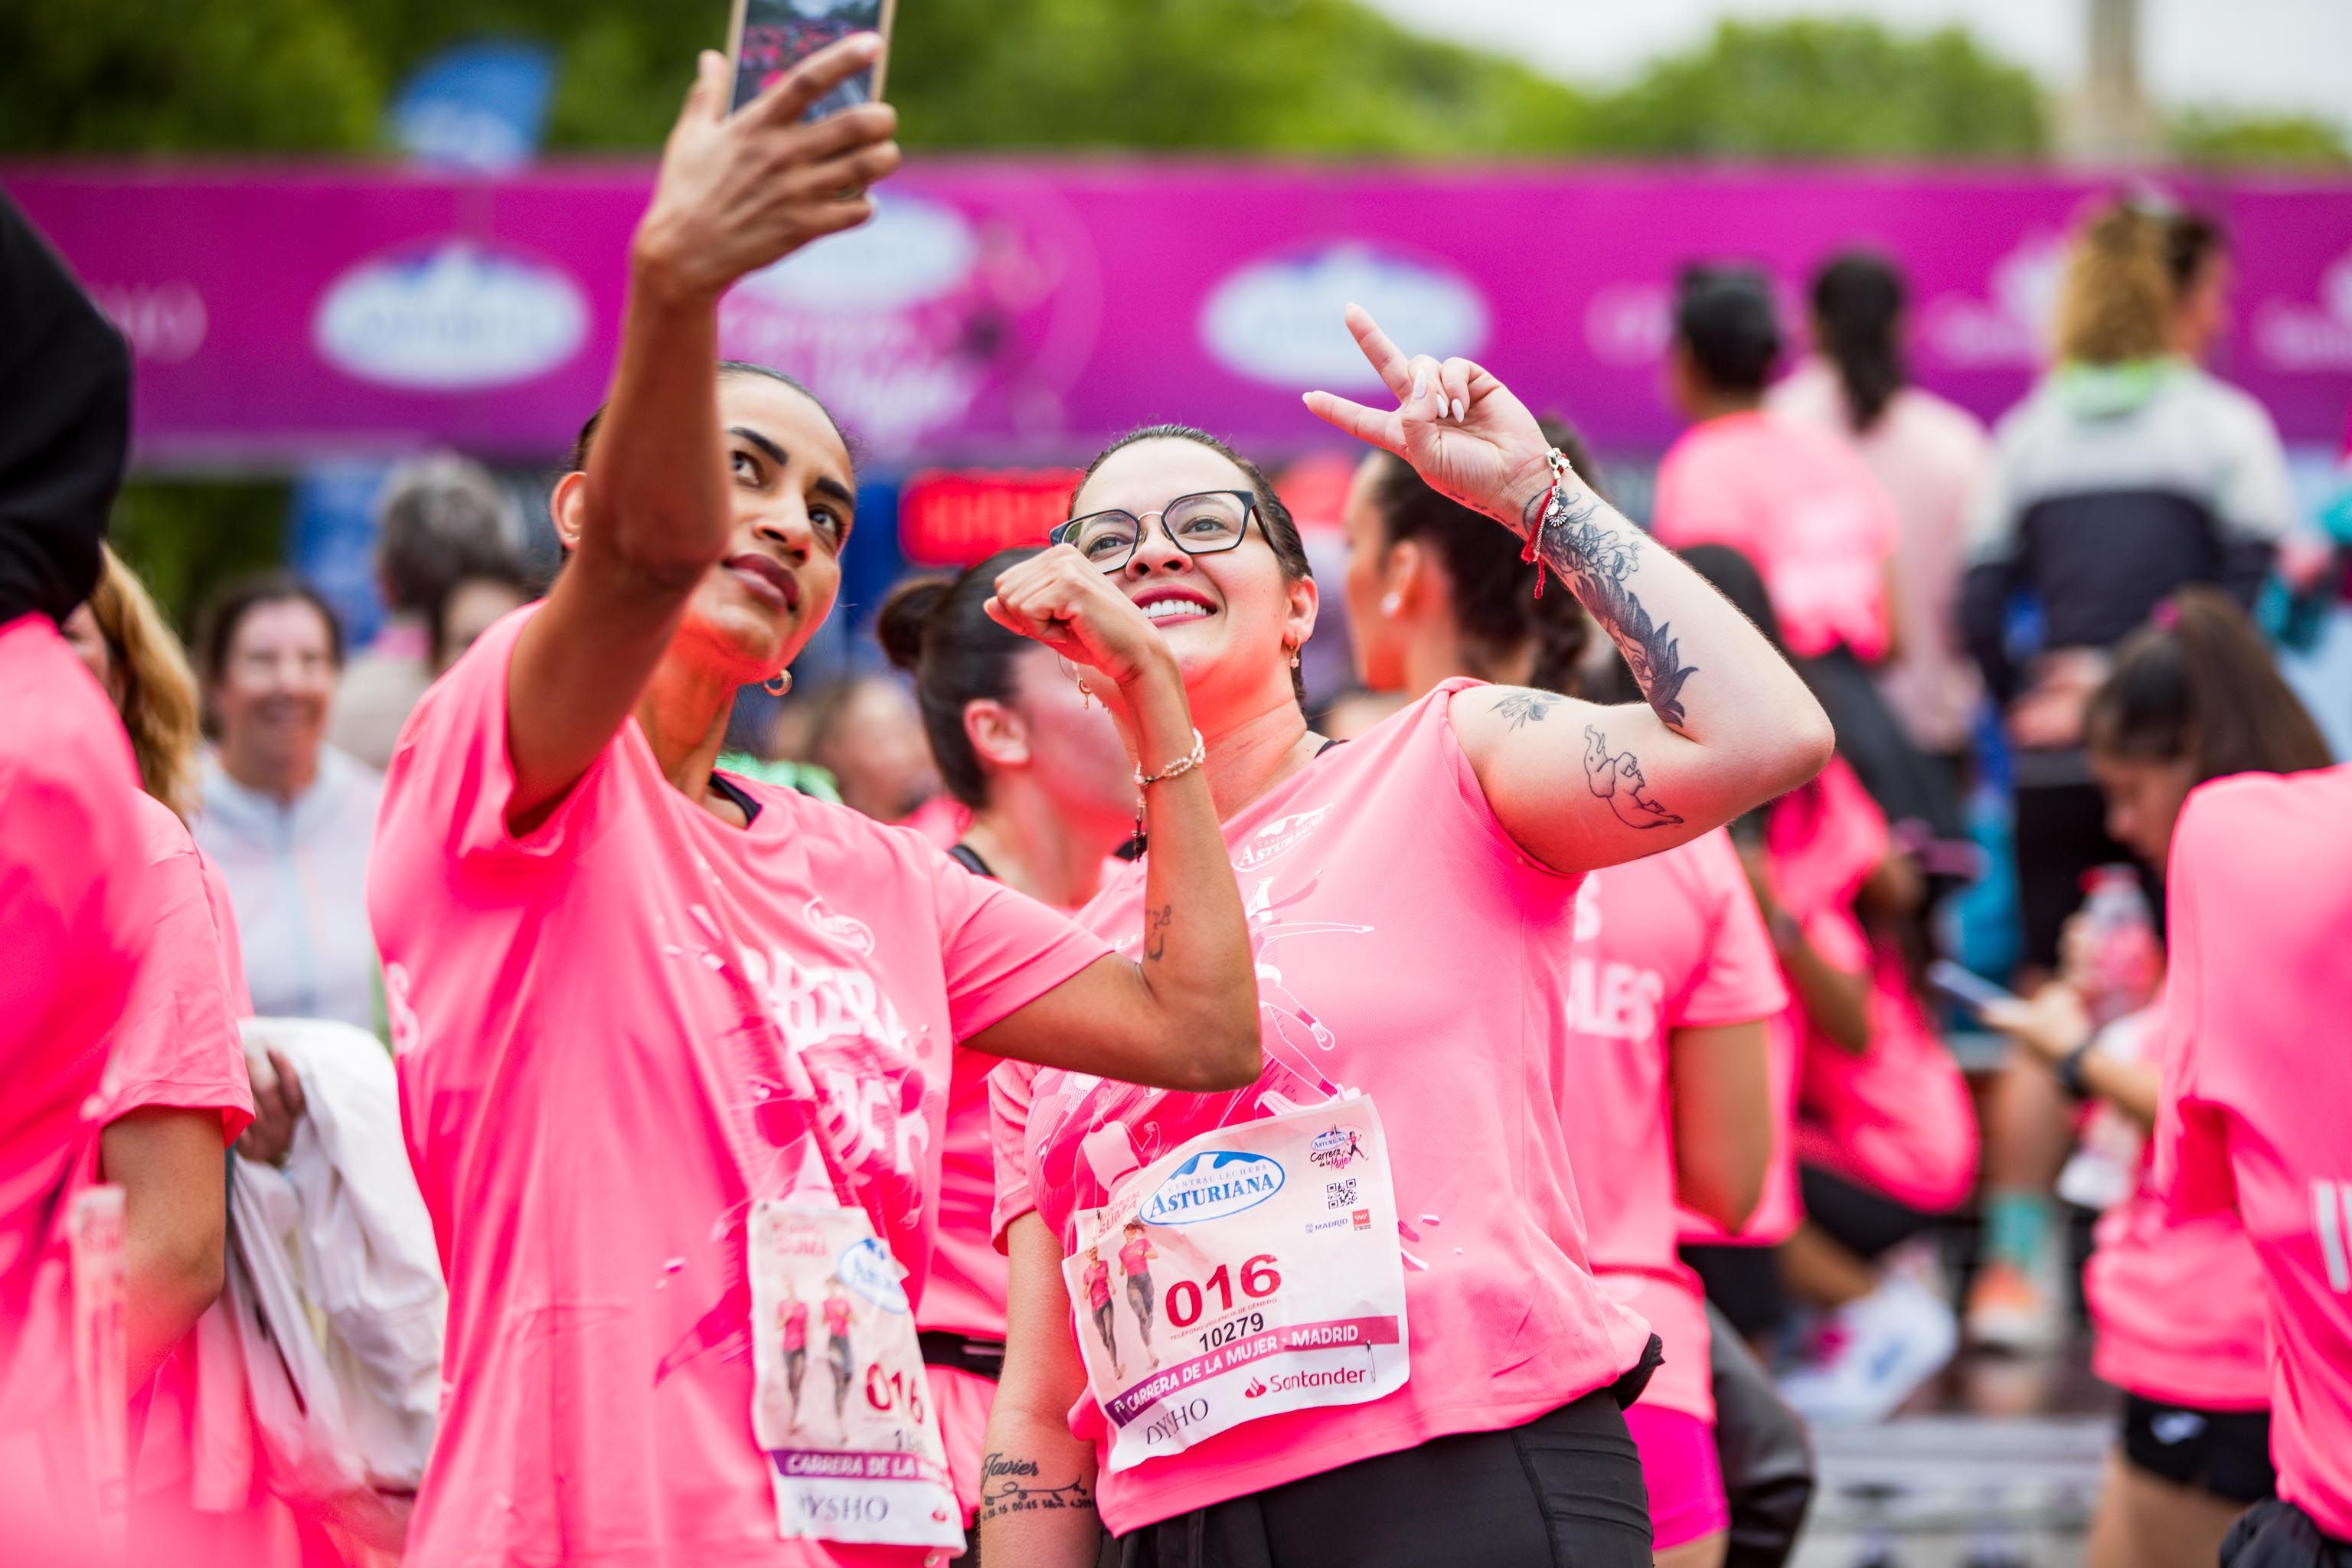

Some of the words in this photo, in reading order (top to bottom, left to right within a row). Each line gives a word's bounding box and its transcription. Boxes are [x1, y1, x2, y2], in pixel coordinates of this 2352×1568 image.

[1314, 1136, 1346, 1149] ASTURINA
[1168, 1176, 1214, 1193] CENTRAL
[1219, 1163, 1268, 1181] LECHERA
[1149, 1174, 1276, 1219] ASTURIANA
[1315, 1217, 1348, 1231] MADRID
[1165, 1254, 1282, 1328] 016
[1199, 1312, 1264, 1352] 10279
[1126, 1372, 1180, 1411] CARRERA
[1182, 1363, 1202, 1383] DE
[1205, 1354, 1223, 1373] LA
[1227, 1336, 1278, 1366] MUJER
[1292, 1325, 1359, 1348] MADRID
[1269, 1367, 1367, 1393] Santander
[786, 1453, 864, 1476] CARRERA
[866, 1455, 890, 1477] DE
[892, 1457, 916, 1478] LA
[981, 1452, 1040, 1493] Javier
